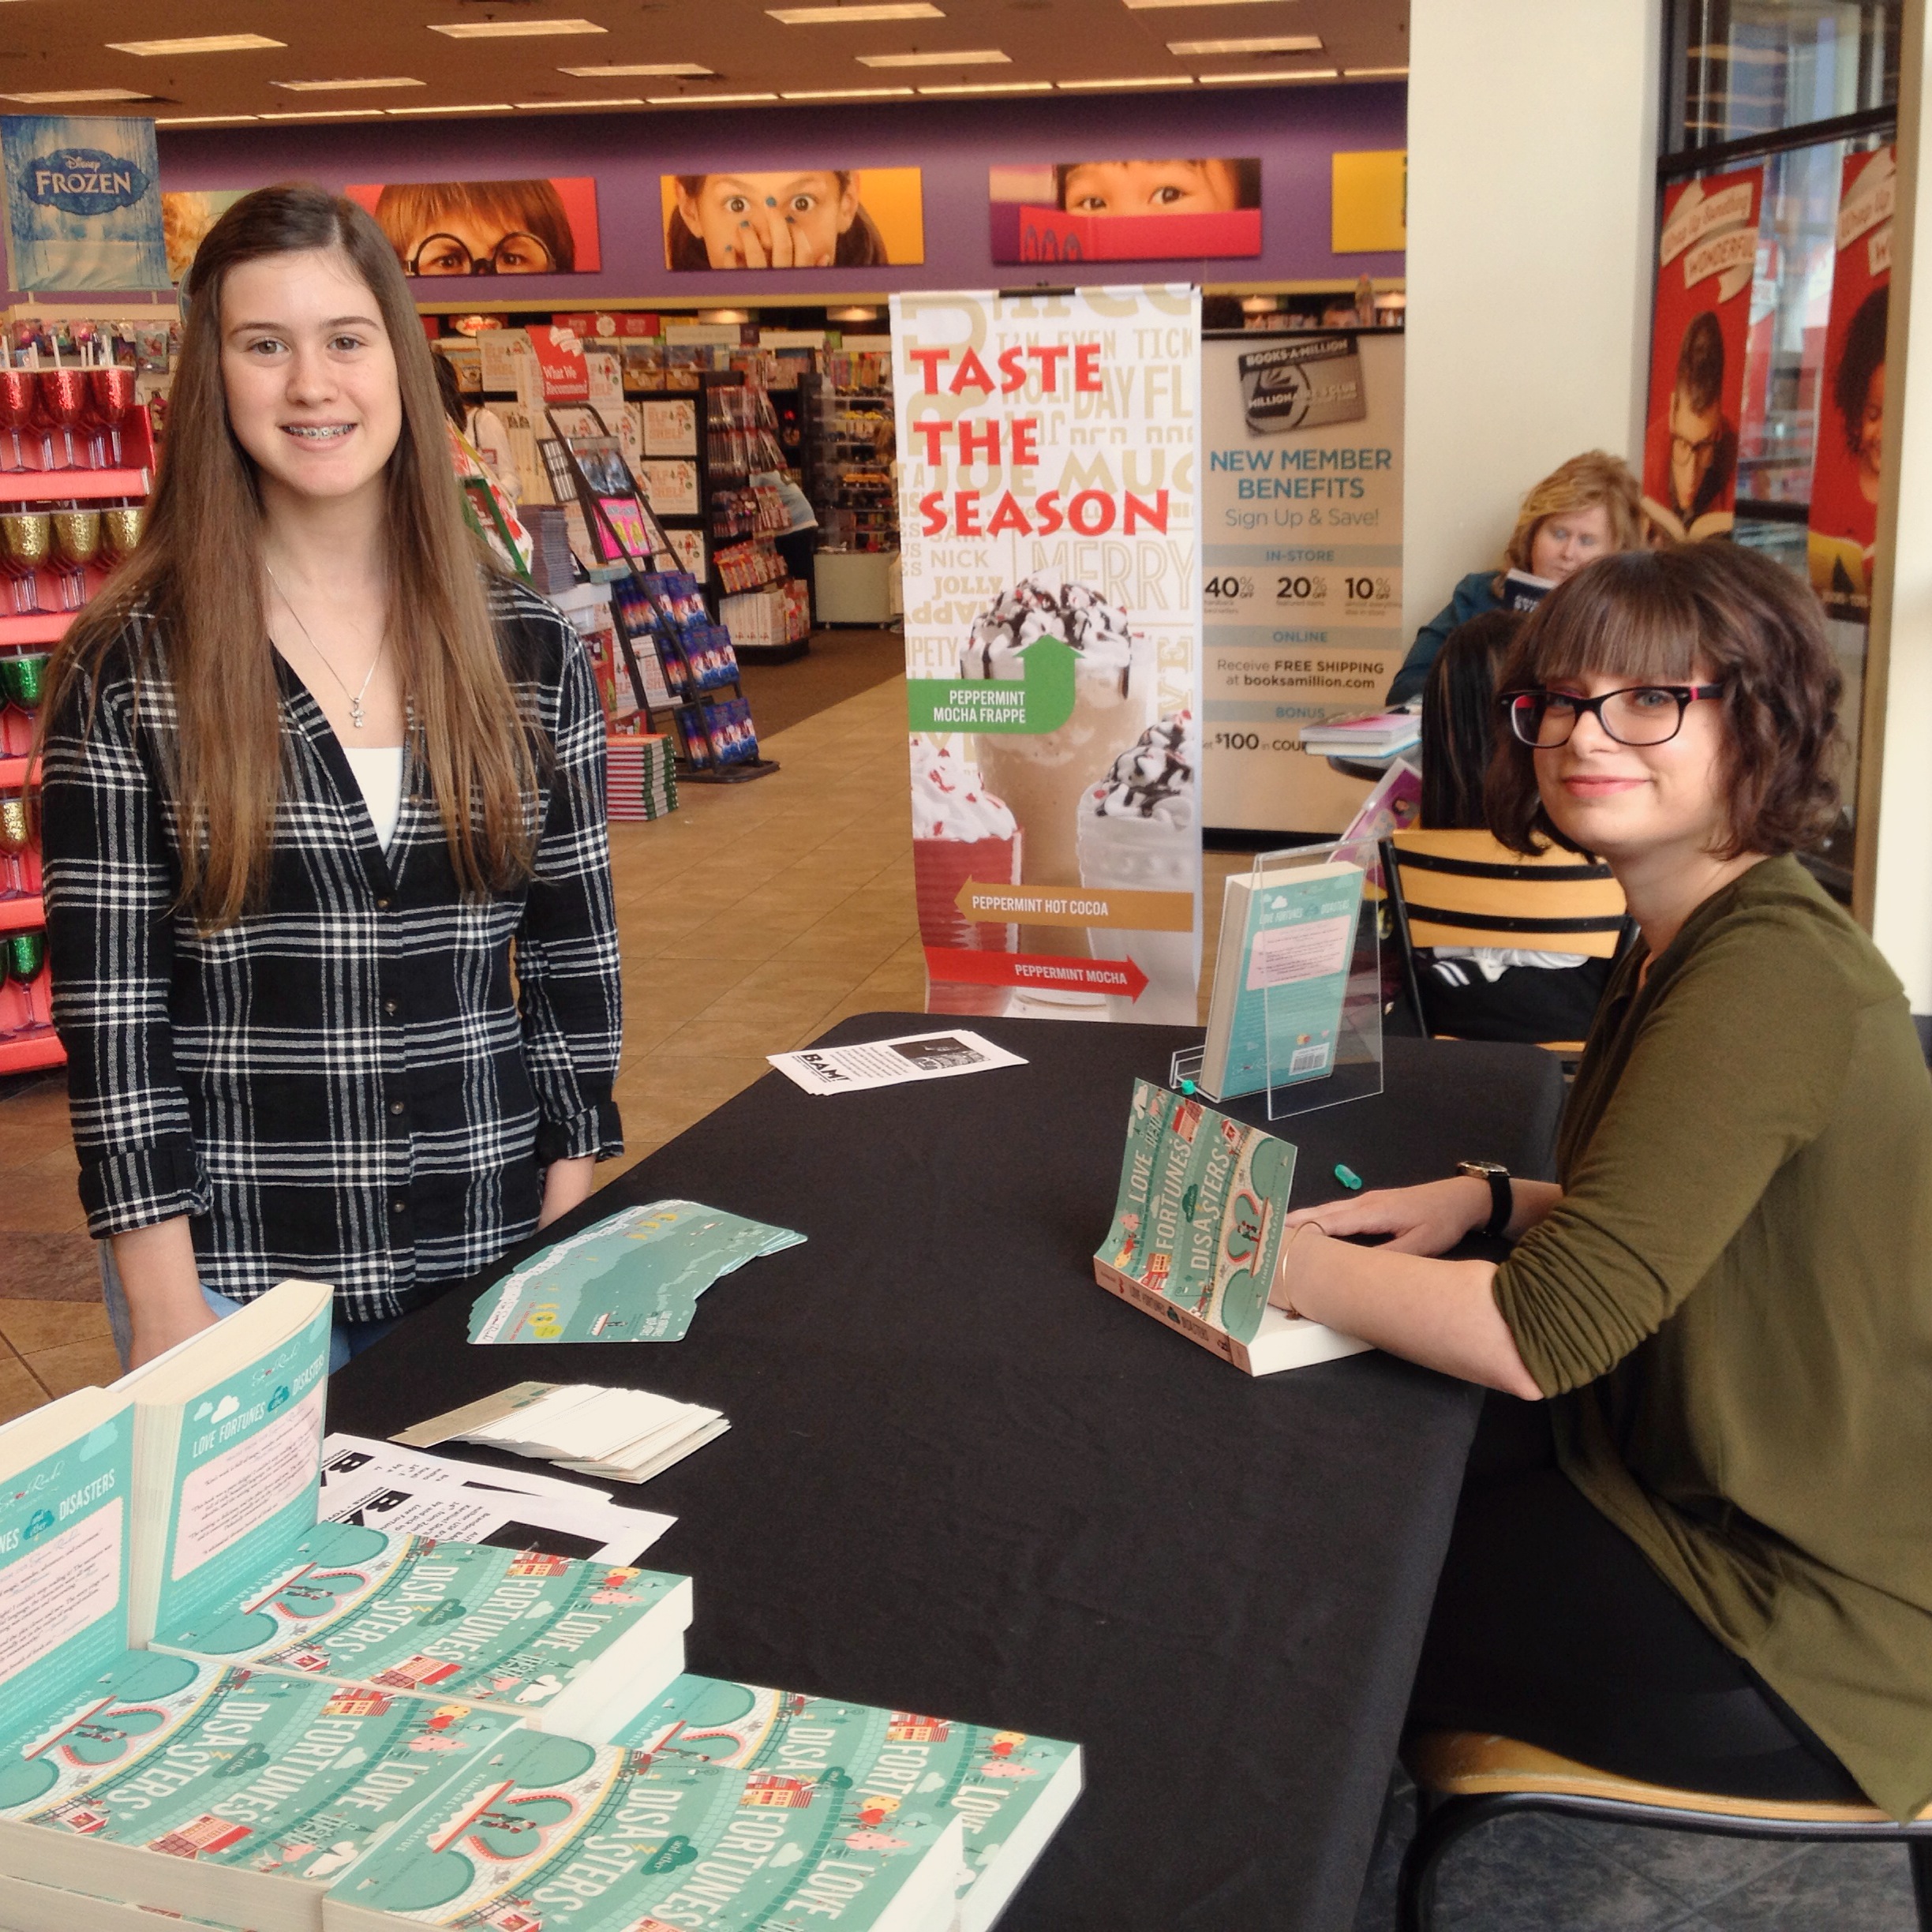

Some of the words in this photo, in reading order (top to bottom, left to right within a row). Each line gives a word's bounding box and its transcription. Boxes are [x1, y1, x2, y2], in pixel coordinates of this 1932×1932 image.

[63, 155, 101, 172] Disney
[36, 170, 132, 196] FROZEN
[542, 365, 564, 380] What
[564, 365, 577, 380] We
[909, 343, 1103, 396] TASTE
[912, 417, 1039, 466] THE
[1210, 450, 1274, 471] NEW
[1281, 447, 1392, 470] MEMBER
[1237, 477, 1365, 500] BENEFITS
[919, 489, 1168, 537] SEASON
[1225, 507, 1268, 530] Sign
[1274, 509, 1302, 530] Up
[1308, 509, 1322, 526] &
[1328, 508, 1379, 526] Save!
[930, 549, 989, 568] NICK
[1265, 550, 1335, 562] IN-STORE
[931, 575, 1003, 601] JOLLY
[1204, 575, 1255, 598] 40%
[1276, 576, 1327, 598] 20%
[1345, 577, 1391, 600] 10%
[1273, 631, 1328, 642] ONLINE
[1218, 660, 1270, 672] Receive
[1275, 661, 1312, 672] FREE
[1316, 661, 1384, 674] SHIPPING
[1226, 676, 1240, 686] at
[1244, 675, 1375, 689] booksamillion.com
[949, 690, 1025, 706] PEPPERMINT
[934, 707, 977, 723] MOCHA
[980, 707, 1026, 724] FRAPPE
[1275, 707, 1325, 718] BONUS
[1215, 732, 1260, 750] $100
[972, 896, 1043, 912] PEPPERMINT
[1045, 900, 1067, 914] HOT
[1069, 900, 1108, 915] COCOA
[1015, 964, 1084, 981] PEPPERMINT
[1086, 969, 1127, 985] MOCHA
[800, 1054, 853, 1083] BAM!
[1128, 1149, 1153, 1204] LOVE
[1155, 1138, 1192, 1250] FORTUNES
[1190, 1148, 1230, 1271] DISASTERS
[193, 1429, 217, 1458] LOVE
[218, 1401, 266, 1443] FORTUNES
[59, 1467, 115, 1522] DISASTERS
[325, 1565, 460, 1654] DISASTERS
[421, 1578, 522, 1663] FORTUNES
[530, 1611, 612, 1653] LOVE
[107, 1702, 271, 1813] DISASTERS
[211, 1718, 363, 1823] FORTUNES
[335, 1762, 429, 1813] LOVE
[441, 1773, 488, 1813] KIMBERLY
[396, 1811, 443, 1853] KARALIUS
[533, 1788, 684, 1912] DISASTERS
[671, 1840, 690, 1858] and
[649, 1812, 790, 1928] FORTUNES
[783, 1860, 875, 1920] LOVE
